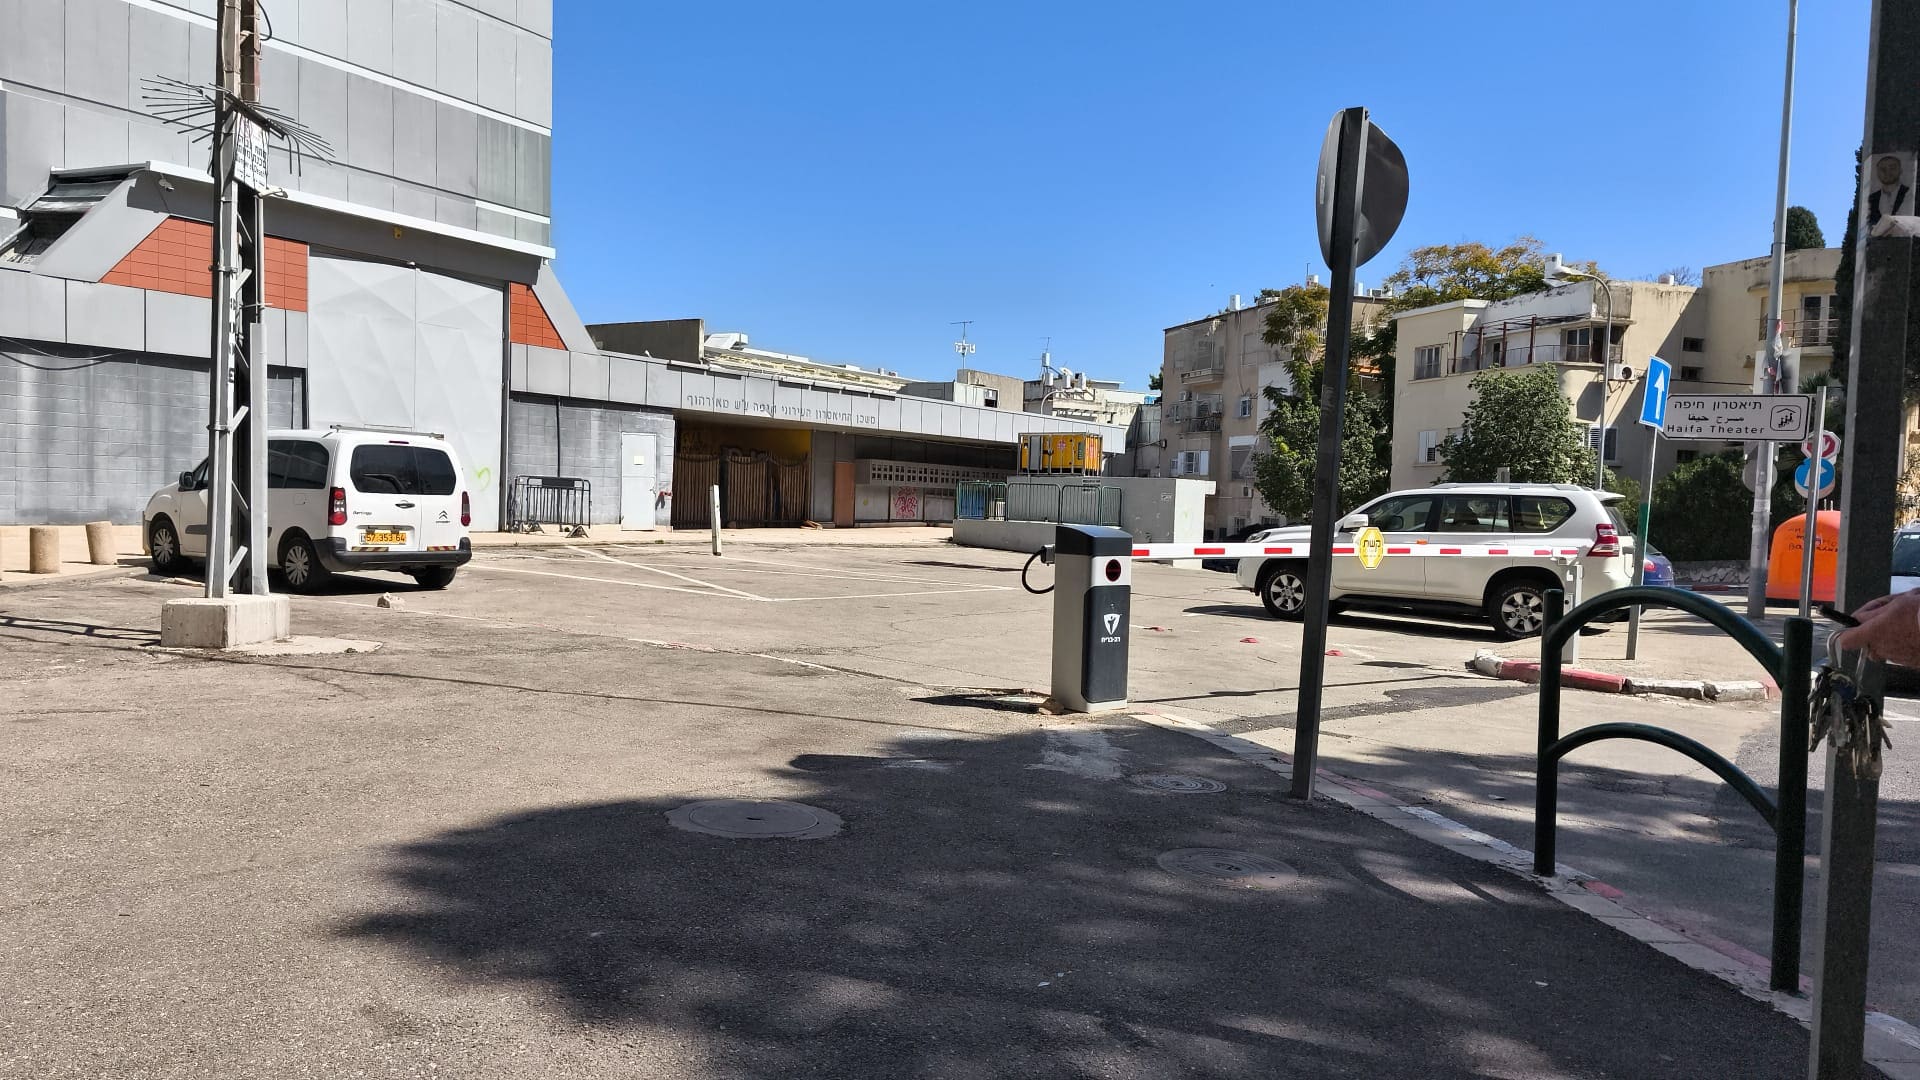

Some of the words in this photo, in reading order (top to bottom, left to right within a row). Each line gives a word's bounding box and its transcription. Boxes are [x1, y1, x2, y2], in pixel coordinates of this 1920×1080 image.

[1674, 401, 1705, 409] חיפה
[1713, 401, 1762, 411] תיאטרון
[856, 414, 876, 425] משכן
[1667, 424, 1703, 433] Haifa
[1710, 425, 1765, 434] Theater
[1363, 540, 1381, 552] קשת
